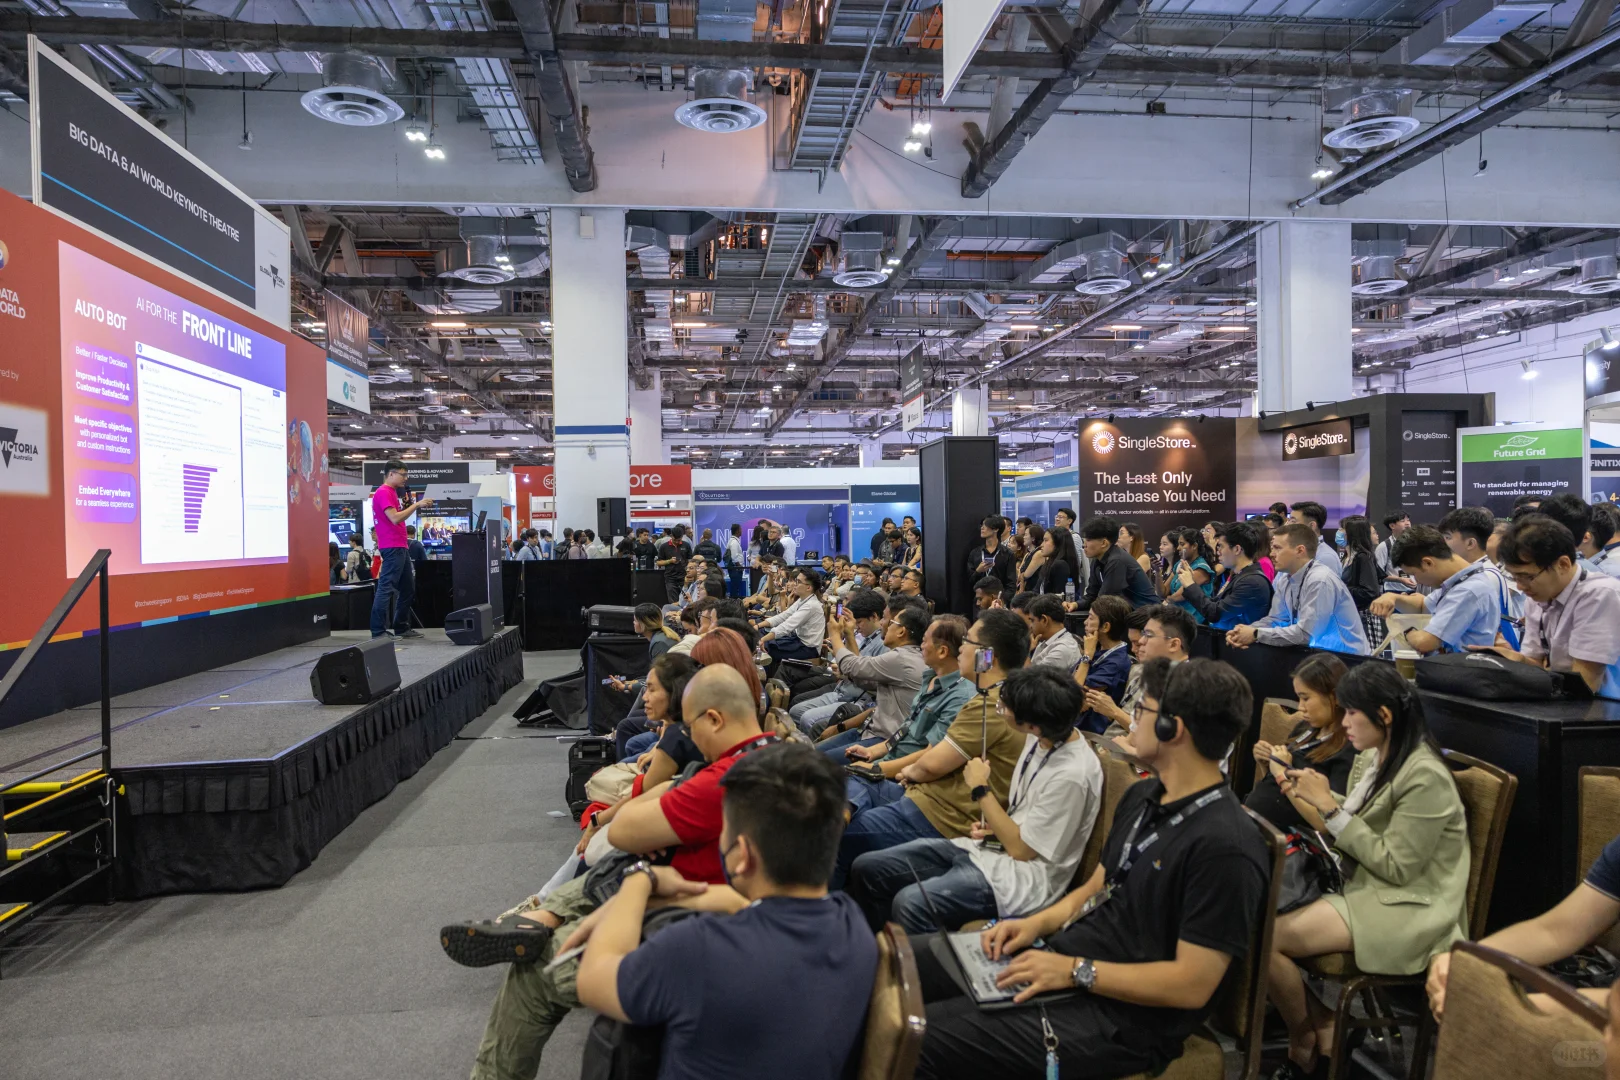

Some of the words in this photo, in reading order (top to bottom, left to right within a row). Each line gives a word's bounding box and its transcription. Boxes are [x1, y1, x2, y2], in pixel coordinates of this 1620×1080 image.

[69, 122, 88, 147] BIG
[90, 136, 120, 167] DATA
[121, 155, 129, 172] &
[130, 162, 140, 179] AI
[140, 167, 173, 199] WORLD
[173, 189, 208, 222] KEYNOTE
[208, 212, 240, 242] THEATRE
[0, 287, 20, 304] ATA
[0, 301, 26, 319] ORLD
[74, 298, 104, 322] AUTO
[106, 310, 128, 331] BOT
[136, 297, 144, 311] AI
[146, 300, 162, 318] FOR
[163, 308, 178, 325] THE
[182, 310, 226, 348] FRONT
[228, 330, 252, 360] LINE
[76, 346, 90, 358] Better
[94, 352, 108, 363] Faster
[109, 356, 128, 368] Decision
[10, 370, 19, 381] by
[76, 369, 96, 383] Improve
[97, 375, 126, 392] Productivity
[76, 381, 101, 394] Customer
[102, 387, 130, 402] Satisfaction
[74, 414, 88, 426] Meet
[88, 419, 108, 429] specific
[108, 422, 132, 434] objectives
[80, 428, 90, 437] with
[91, 431, 120, 442] personalized
[76, 440, 86, 448] and
[88, 442, 104, 450] custom
[105, 444, 130, 454] instructions
[1494, 449, 1524, 458] Future
[1525, 448, 1546, 456] Grid
[13, 454, 33, 462] Australia
[1094, 472, 1120, 484] The
[1126, 472, 1157, 484] Last
[1162, 471, 1192, 486] Only
[1487, 480, 1518, 488] standard
[78, 484, 98, 496] Embed
[100, 486, 130, 498] Everywhere
[1094, 490, 1160, 504] Database
[1163, 490, 1187, 502] You
[1190, 489, 1226, 502] Need
[88, 499, 110, 508] seamless
[110, 500, 134, 509] experience
